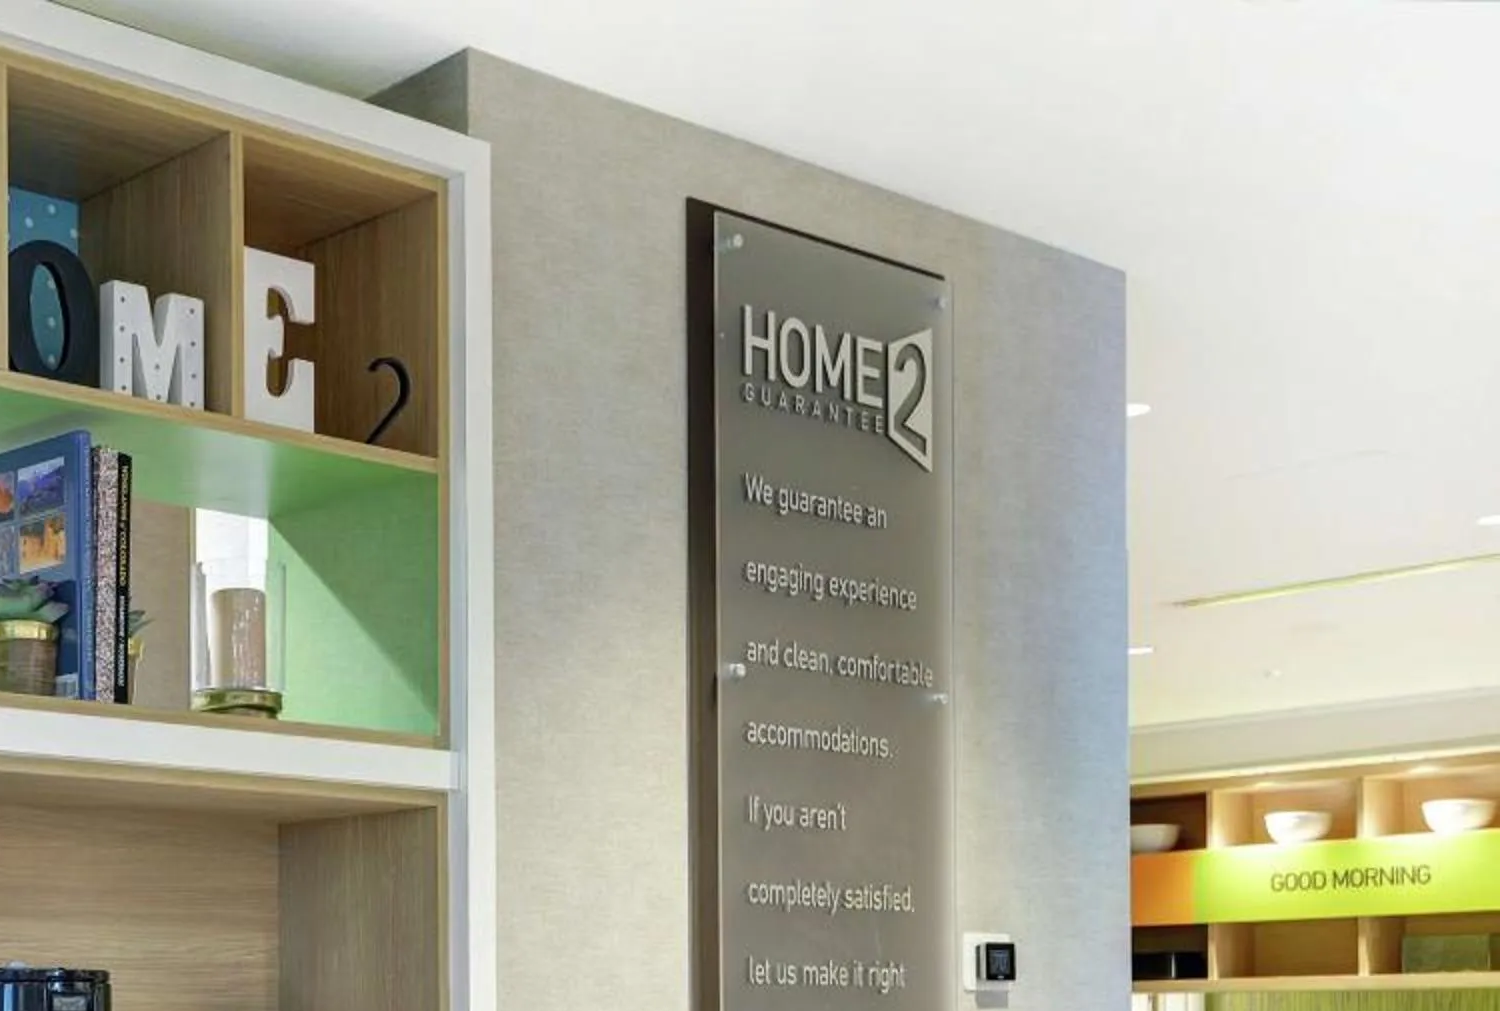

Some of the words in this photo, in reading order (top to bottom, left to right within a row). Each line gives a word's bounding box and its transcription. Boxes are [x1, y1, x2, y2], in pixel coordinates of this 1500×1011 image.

[743, 382, 885, 433] GUARANTEE
[744, 472, 773, 505] We
[779, 487, 863, 524] guarantee
[867, 505, 887, 529] an
[746, 560, 824, 600] engaging
[828, 576, 918, 611] experience
[747, 639, 779, 667] and
[837, 653, 934, 688] comfortable
[747, 720, 894, 759] accommodations.
[749, 795, 760, 824] If
[763, 803, 795, 832] you
[799, 802, 847, 831] aren't
[749, 878, 840, 917] completely
[1270, 870, 1328, 893] GOOD
[1331, 863, 1432, 890] MORNING
[749, 954, 771, 985] let
[776, 962, 798, 985] us
[802, 959, 849, 987] make
[852, 959, 864, 988] it
[868, 960, 906, 994] right
